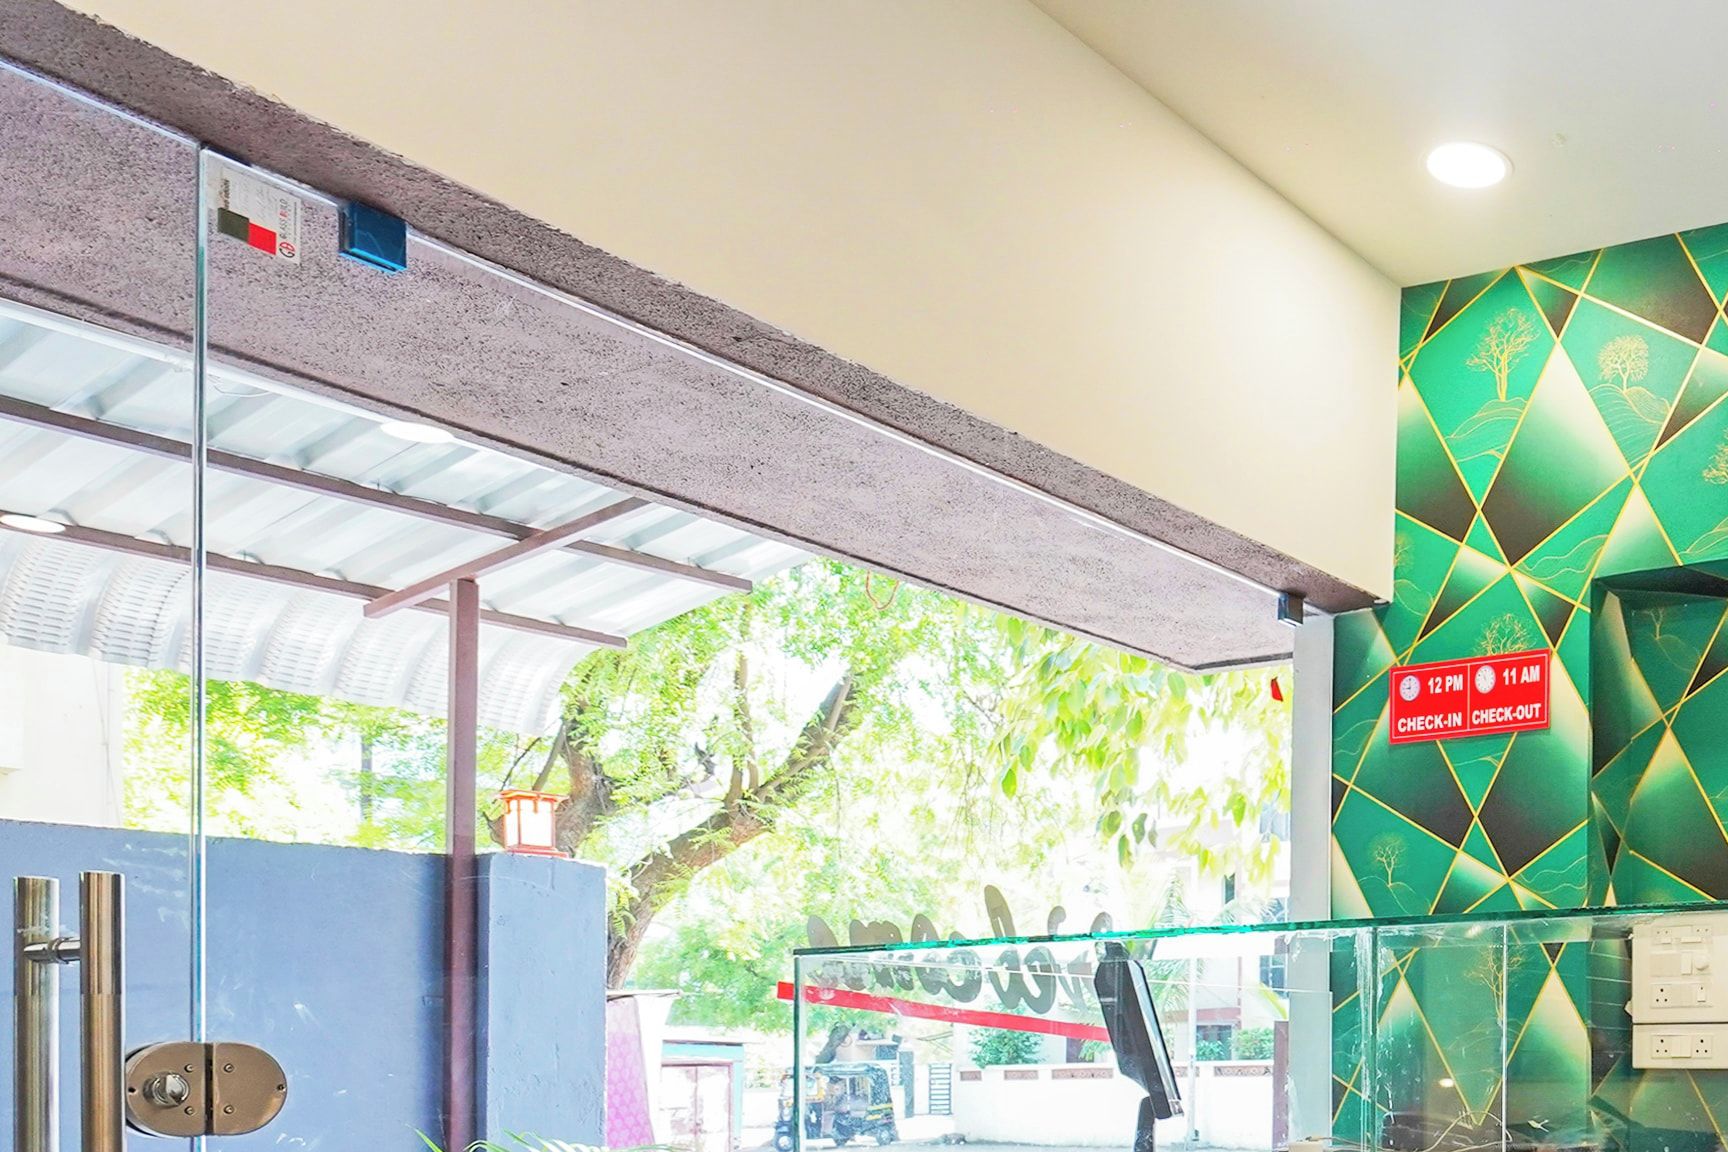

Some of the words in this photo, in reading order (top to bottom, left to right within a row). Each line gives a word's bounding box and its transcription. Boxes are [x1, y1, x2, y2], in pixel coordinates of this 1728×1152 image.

[1427, 676, 1443, 695] 12
[1445, 674, 1464, 693] PM
[1502, 667, 1517, 686] 11
[1520, 665, 1541, 684] AM
[1397, 712, 1463, 733] CHECK-IN
[1471, 703, 1542, 725] CHECK-OUT
